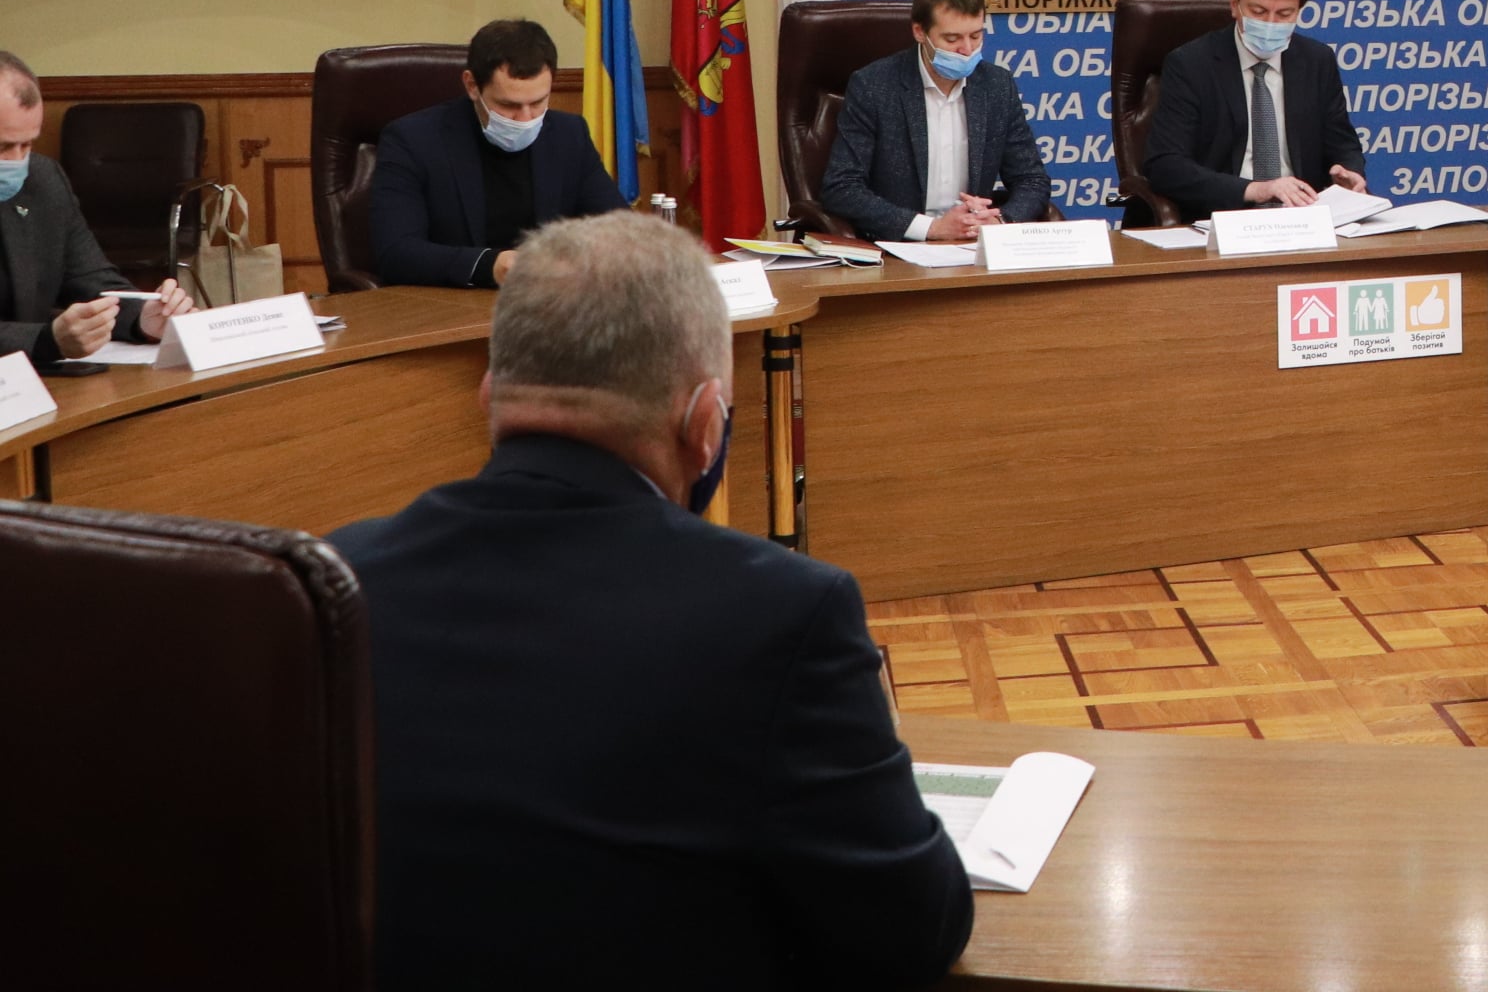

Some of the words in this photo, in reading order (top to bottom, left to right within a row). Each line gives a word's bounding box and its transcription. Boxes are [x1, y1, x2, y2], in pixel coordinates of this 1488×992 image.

[1327, 40, 1486, 71] ОРІЗЬКА
[1053, 47, 1112, 77] ОБ
[1353, 335, 1390, 347] Подумай
[1410, 332, 1446, 342] Зберігай
[1291, 341, 1338, 353] Залишайся
[1348, 348, 1364, 357] про
[1366, 345, 1395, 355] батьків
[1412, 342, 1444, 351] позитив
[1301, 351, 1328, 361] вдома
